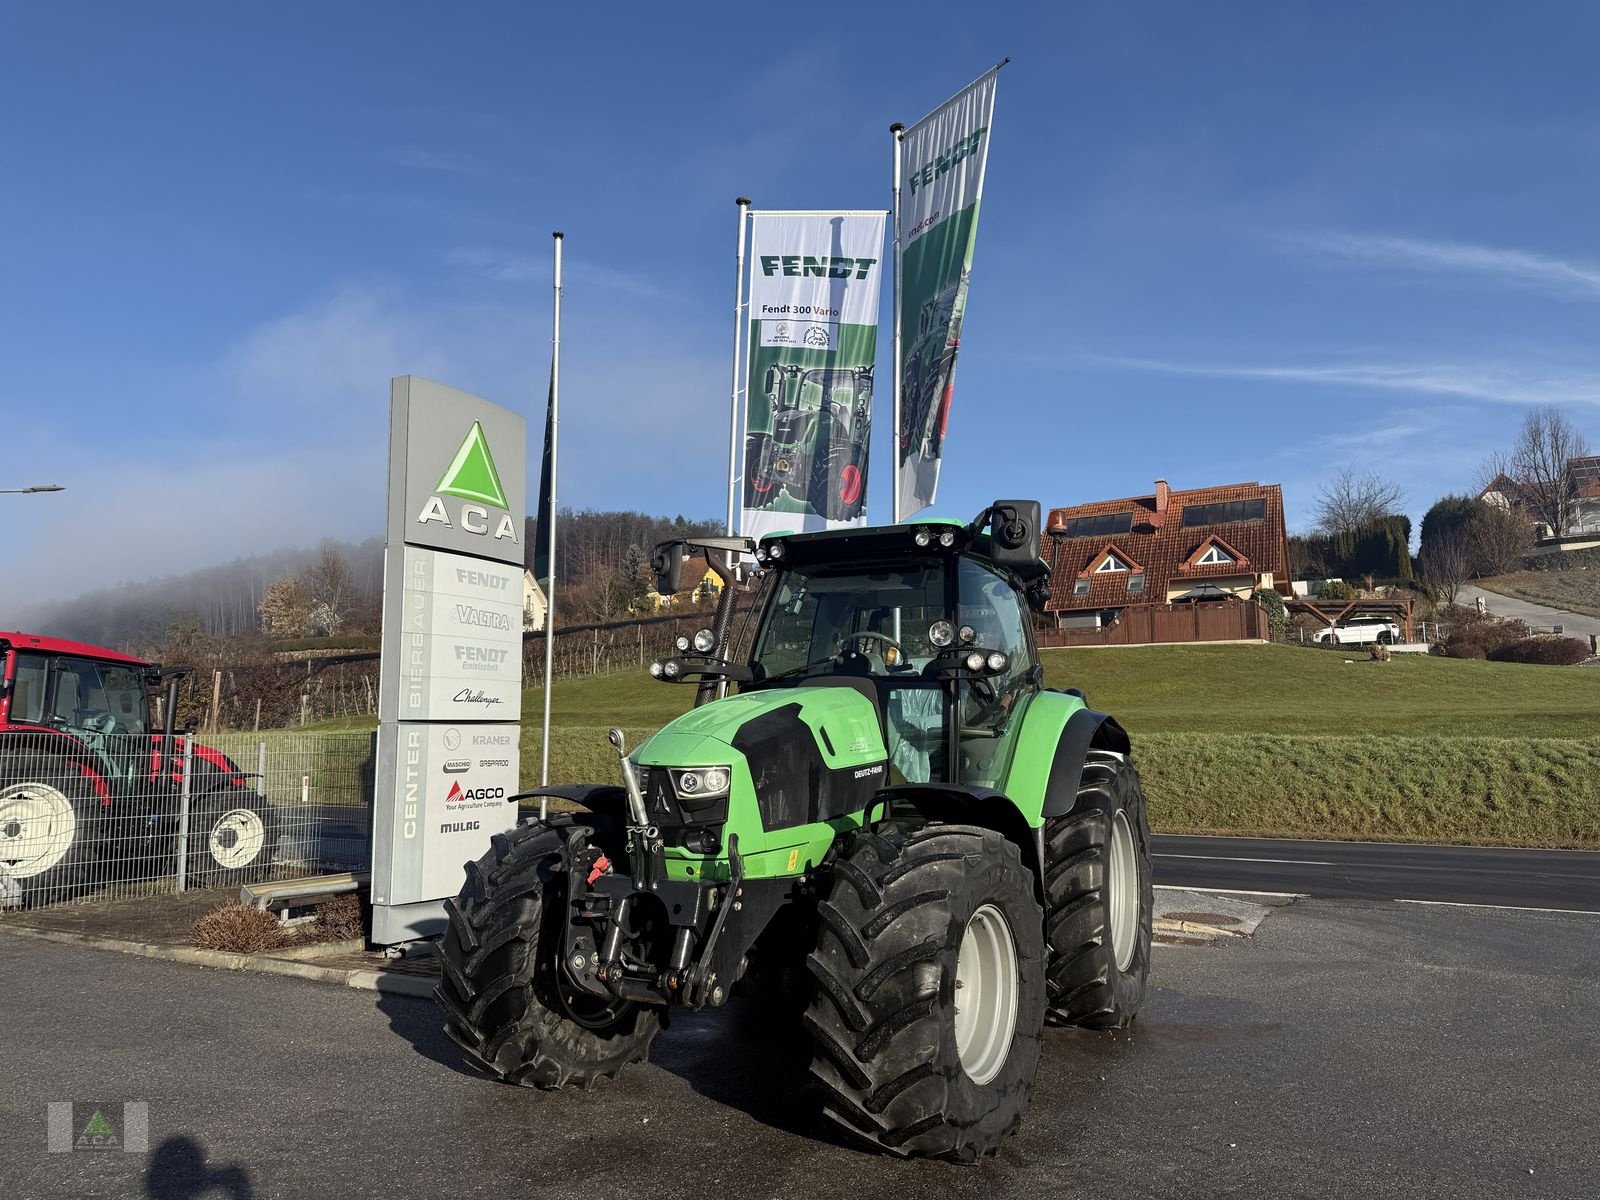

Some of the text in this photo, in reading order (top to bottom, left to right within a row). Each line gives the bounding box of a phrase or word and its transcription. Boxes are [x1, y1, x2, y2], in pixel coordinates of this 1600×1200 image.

[909, 126, 988, 197] FENDT
[760, 255, 877, 280] FENDT
[762, 304, 839, 317] Fendt 300 Vario
[417, 495, 519, 544] ACA
[456, 568, 510, 591] FENDT
[456, 604, 510, 631] VALTRA
[454, 645, 509, 664] FENDT
[452, 688, 505, 709] Challenger
[472, 735, 511, 746] KRAMER
[479, 759, 509, 767] GASPARDO
[854, 765, 882, 779] DEUTZ-FAHR
[403, 731, 421, 840] CENTER
[465, 788, 504, 800] AGCO
[458, 802, 483, 811] Agriculture
[440, 820, 480, 834] MULAG
